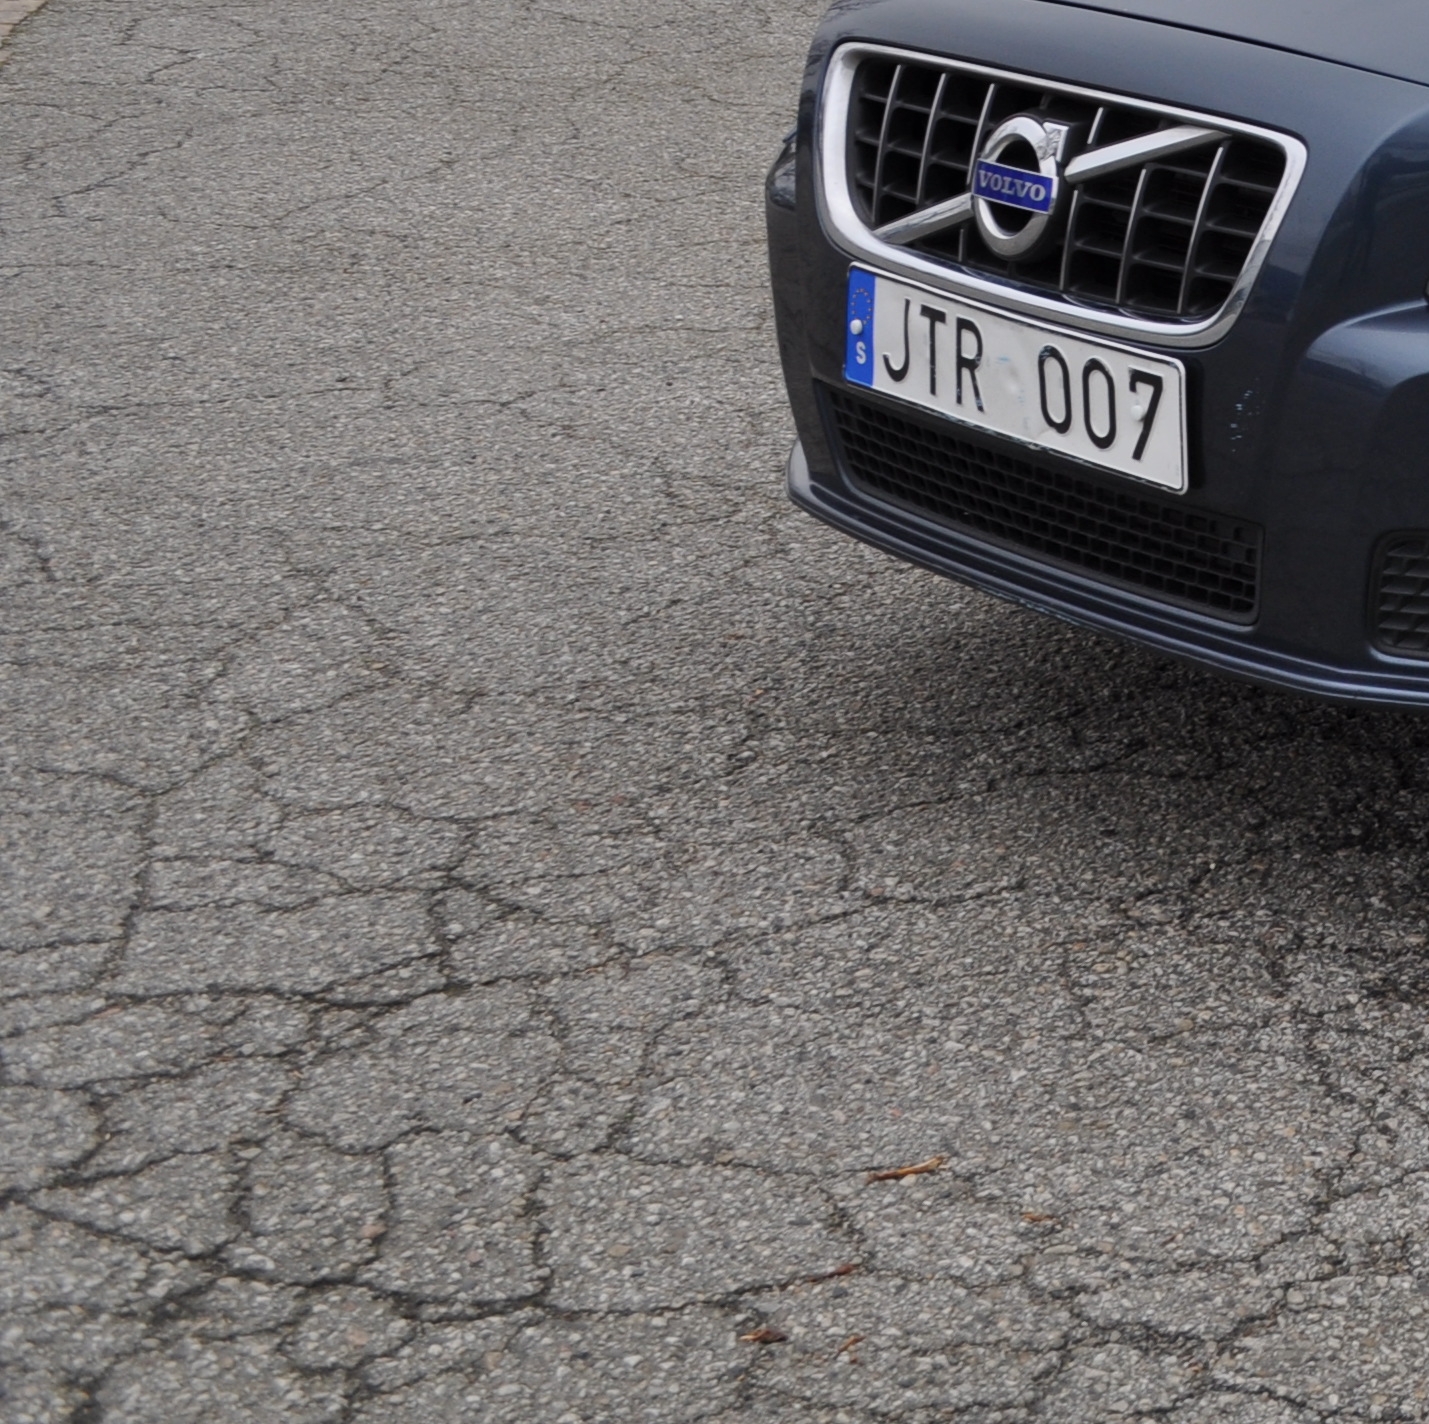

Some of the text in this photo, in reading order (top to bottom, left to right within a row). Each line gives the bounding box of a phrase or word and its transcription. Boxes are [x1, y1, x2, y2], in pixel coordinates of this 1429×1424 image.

[978, 168, 1047, 203] VOLVO
[855, 341, 867, 365] S
[882, 298, 1164, 462] JTR 007
